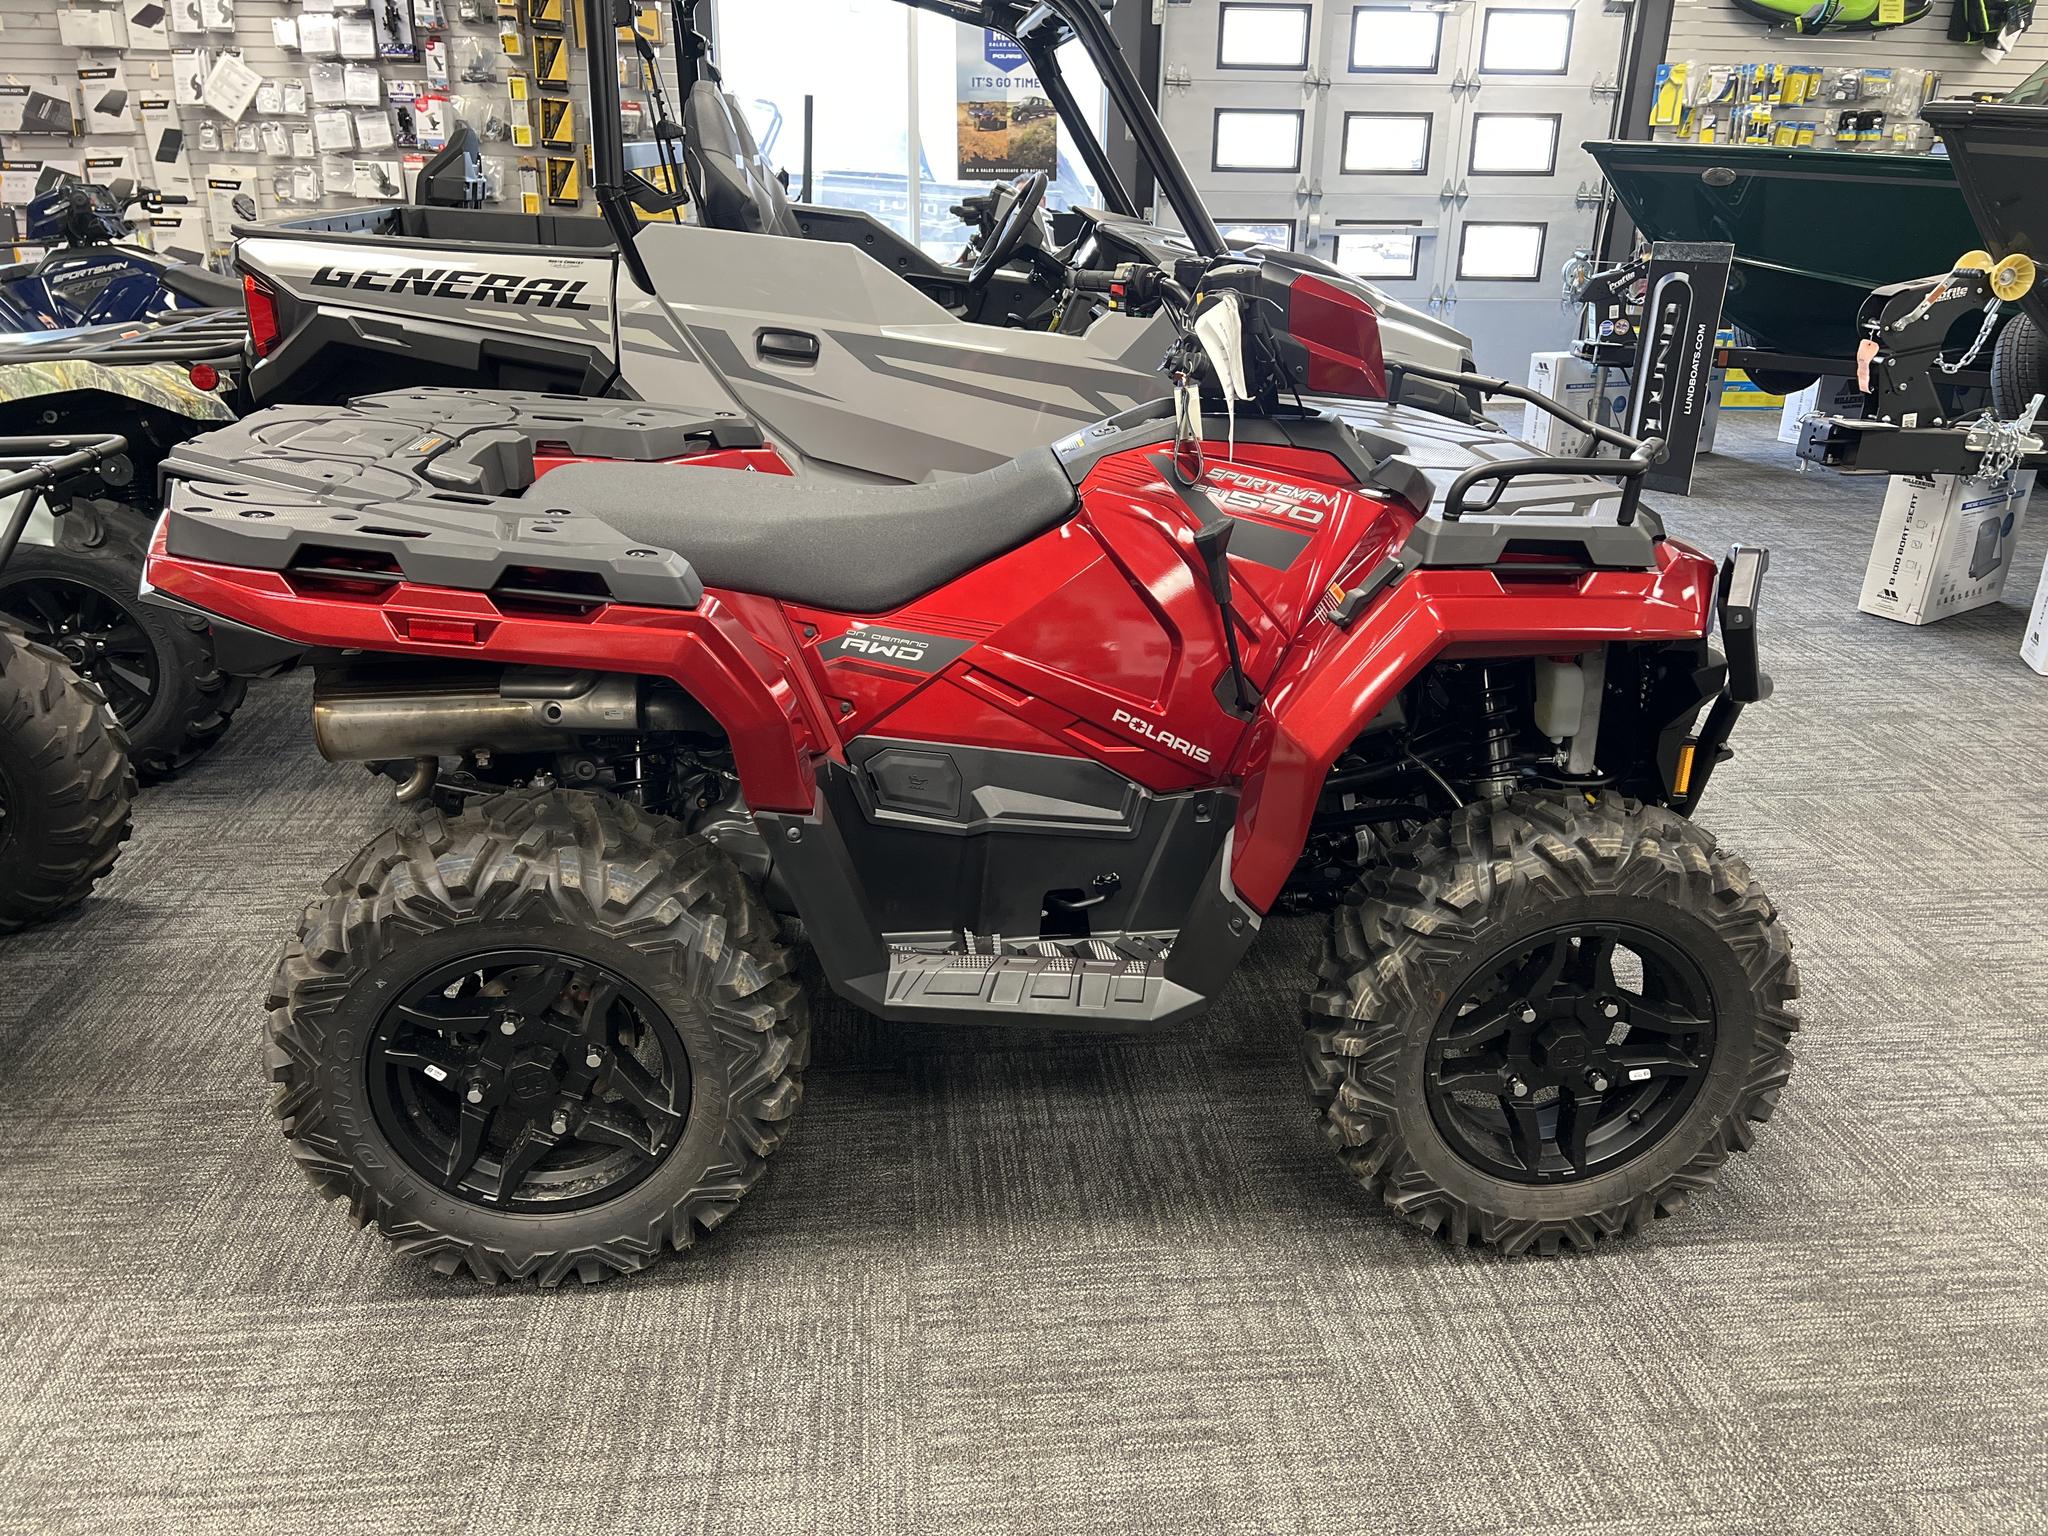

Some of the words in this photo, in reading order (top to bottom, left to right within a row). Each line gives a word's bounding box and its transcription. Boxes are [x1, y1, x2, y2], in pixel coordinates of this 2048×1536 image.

[971, 77, 993, 88] IT'S
[995, 77, 1011, 88] GO
[1014, 77, 1041, 89] TIME
[52, 261, 129, 284] SPORTSMAN
[310, 266, 592, 312] GENERAL
[1683, 323, 1706, 415] LUNDBOATS.COM
[1204, 467, 1342, 507] SPORTSMAN
[1226, 490, 1326, 525] 570
[1897, 527, 1910, 556] BOAT
[1906, 493, 1919, 524] SEAT
[840, 639, 925, 662] AWD
[845, 628, 867, 638] ON
[871, 633, 930, 649] DEMAND
[1111, 708, 1213, 764] POLARIS
